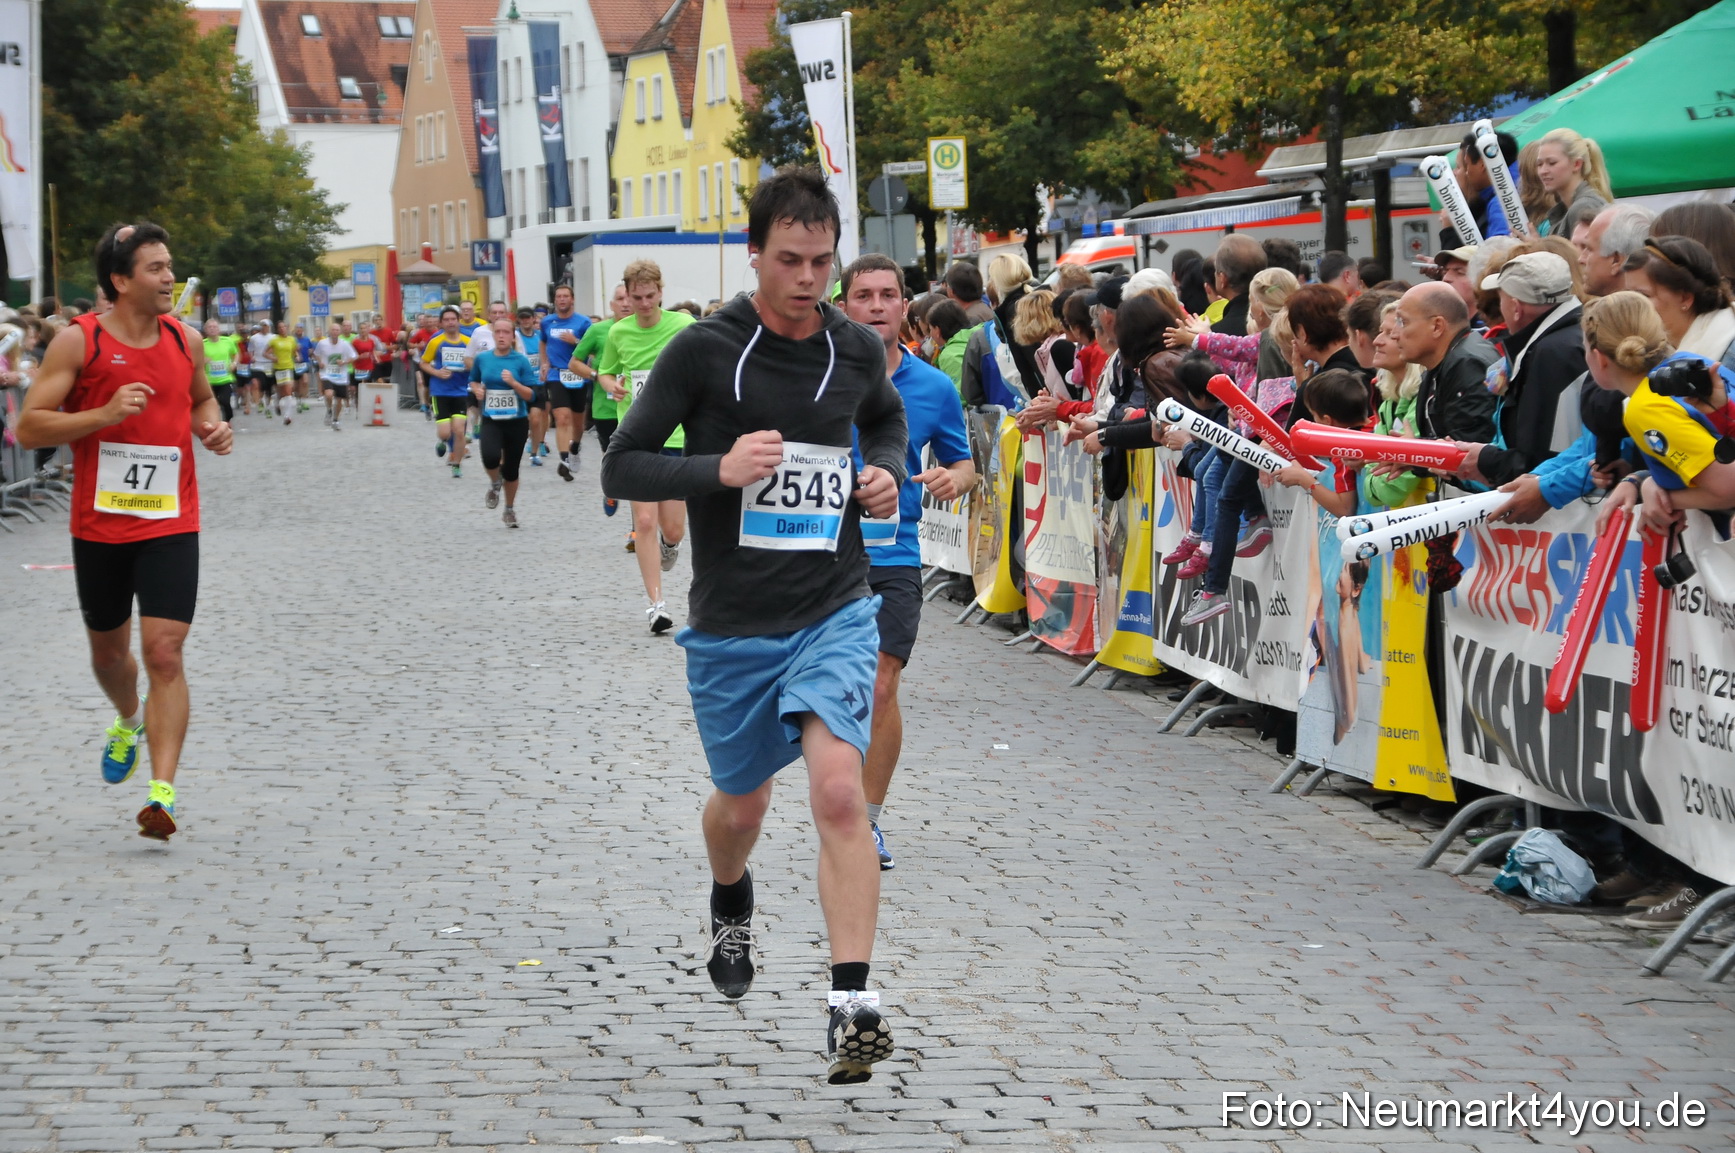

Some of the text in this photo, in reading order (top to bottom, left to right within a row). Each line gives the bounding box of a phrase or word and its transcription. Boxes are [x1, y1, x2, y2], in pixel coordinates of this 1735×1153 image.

[646, 145, 664, 165] HOTEL
[312, 306, 328, 314] TAXI
[445, 352, 464, 361] 2575
[489, 397, 514, 407] 2368
[1190, 417, 1233, 447] BMW
[101, 449, 167, 461] PARTL Neumarkt
[791, 454, 836, 465] Neumarkt
[1377, 451, 1446, 465] Audi BKK
[123, 464, 157, 490] 47
[756, 470, 844, 510] 2543
[111, 496, 162, 508] Ferdinand
[776, 519, 824, 534] Daniel
